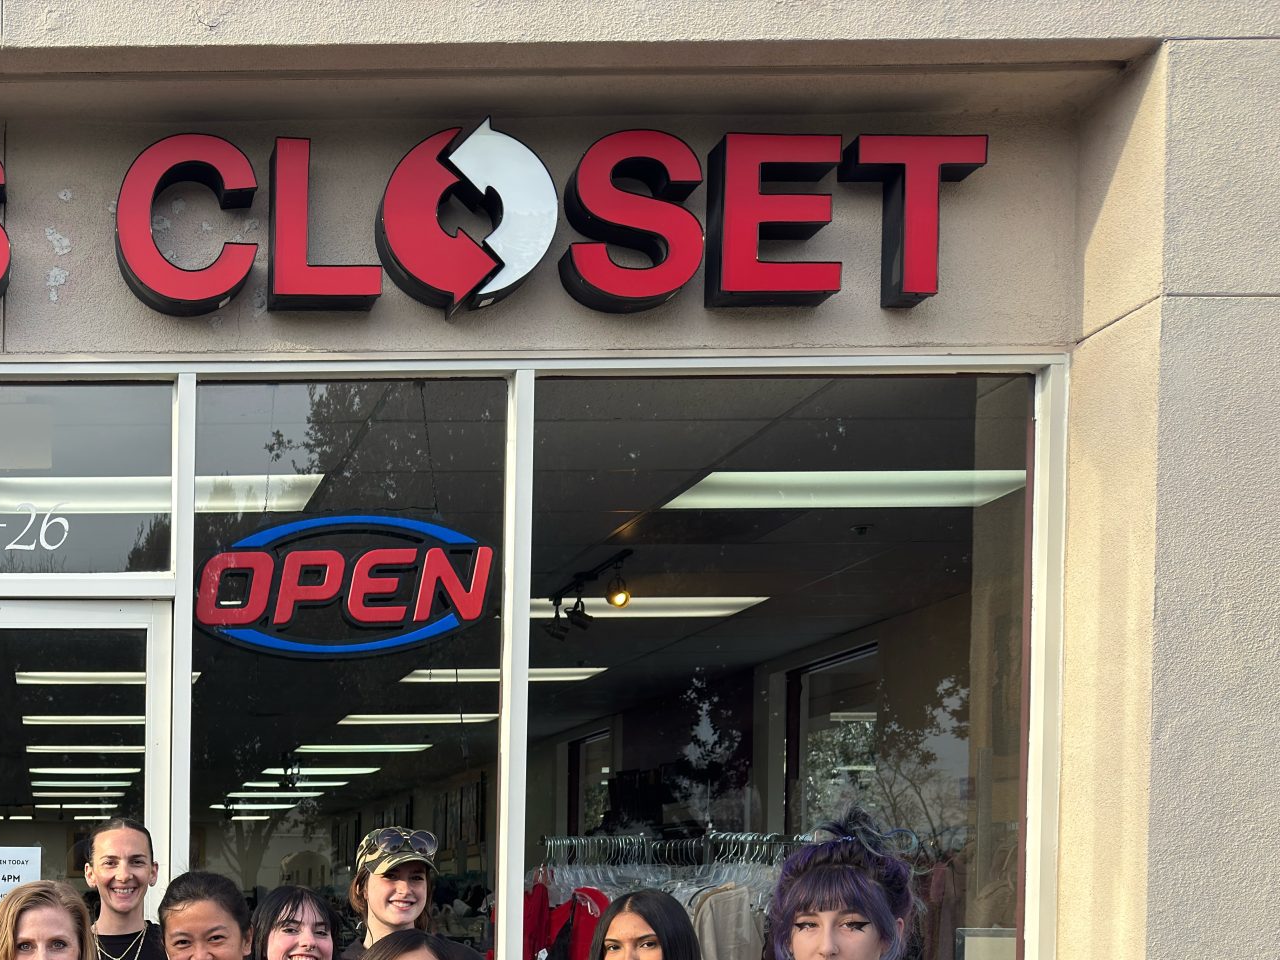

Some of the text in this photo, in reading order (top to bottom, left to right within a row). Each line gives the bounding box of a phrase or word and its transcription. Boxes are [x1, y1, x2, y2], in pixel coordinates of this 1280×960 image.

[115, 116, 989, 320] CLOSET
[195, 546, 493, 626] OPEN
[1, 874, 21, 883] 4PM
